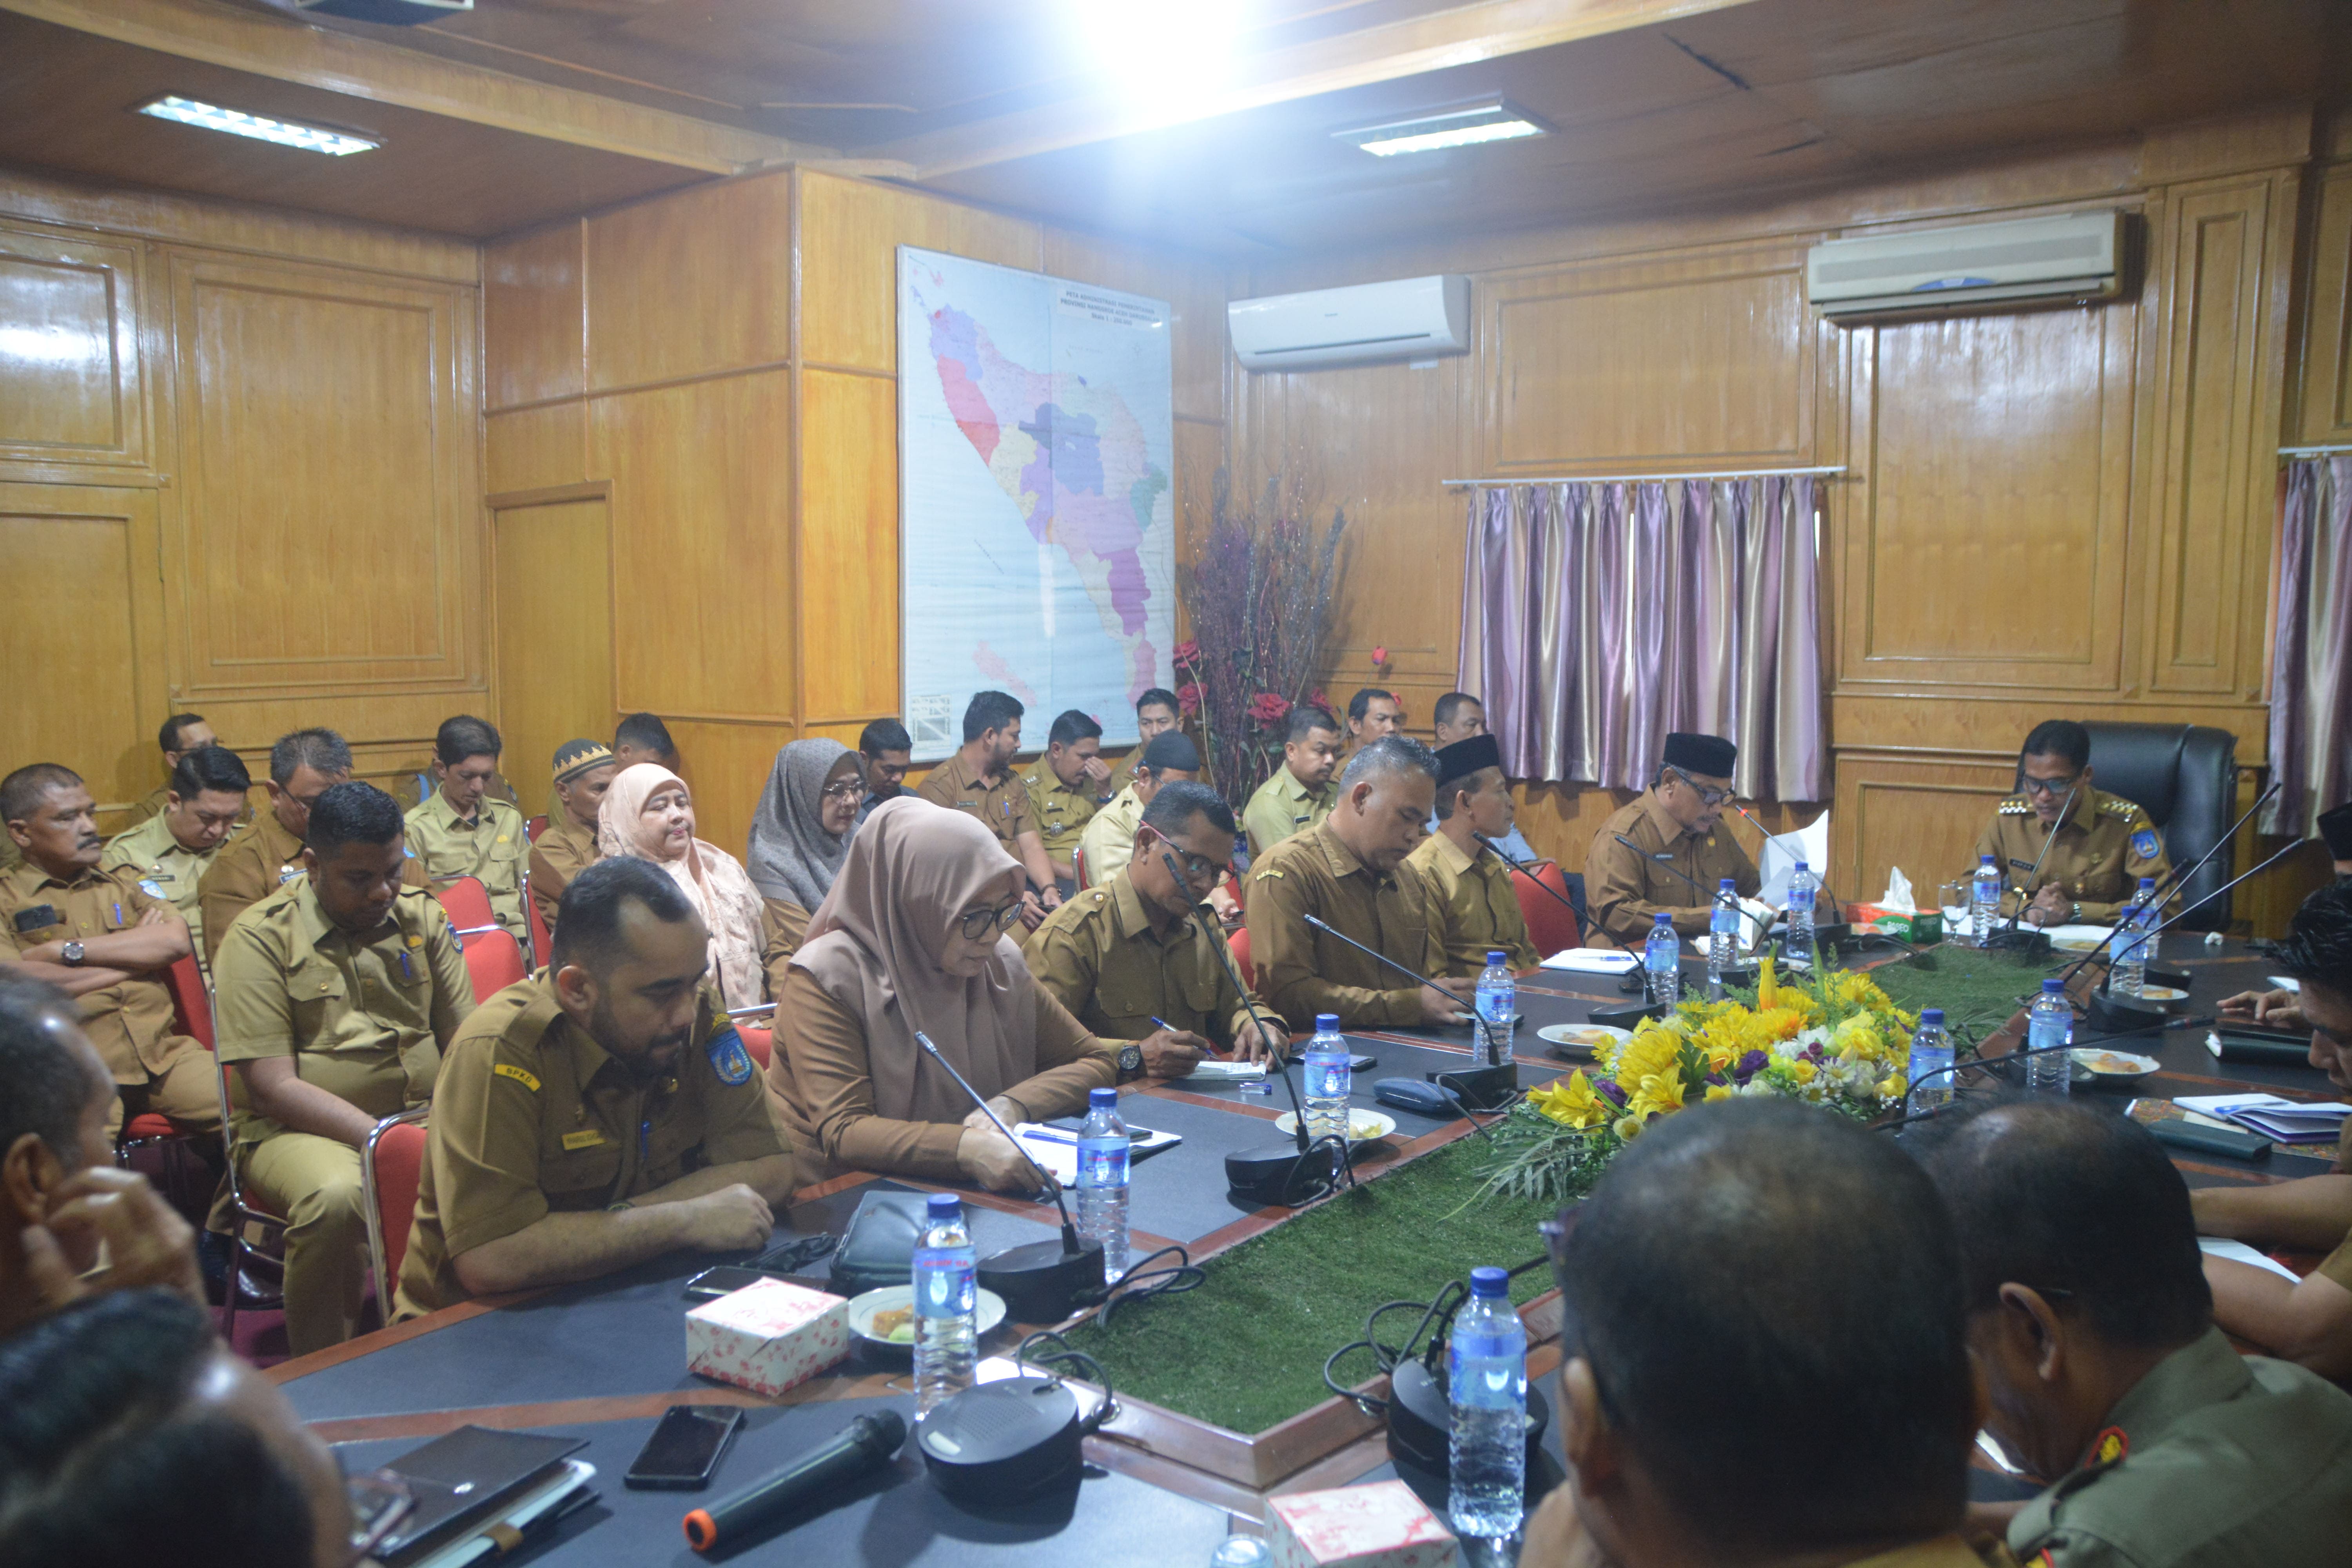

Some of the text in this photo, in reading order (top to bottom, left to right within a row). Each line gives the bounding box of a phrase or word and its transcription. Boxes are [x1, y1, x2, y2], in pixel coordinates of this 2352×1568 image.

[1060, 298, 1086, 309] PROVINSI
[1116, 309, 1128, 317] ACEH
[1080, 294, 1117, 306] ADMINISTRASI
